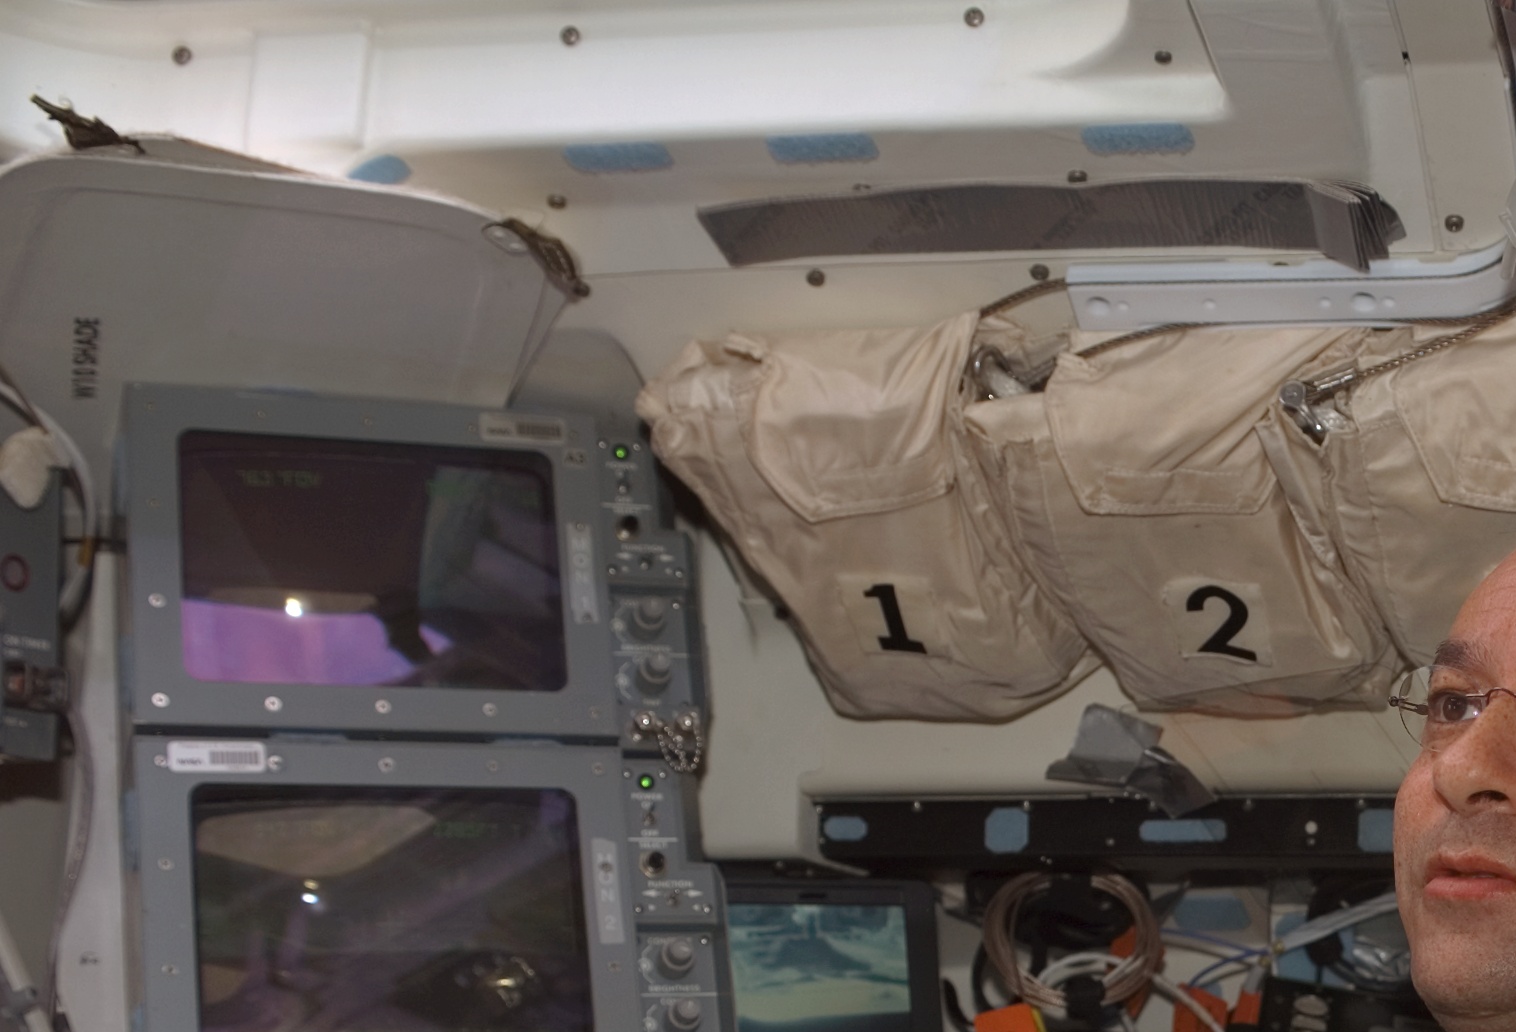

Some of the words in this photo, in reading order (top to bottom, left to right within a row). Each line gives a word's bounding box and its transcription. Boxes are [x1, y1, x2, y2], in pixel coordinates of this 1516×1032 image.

[73, 317, 100, 365] SHADE
[863, 583, 928, 655] 1
[1185, 584, 1257, 661] 2
[604, 914, 617, 931] 2
